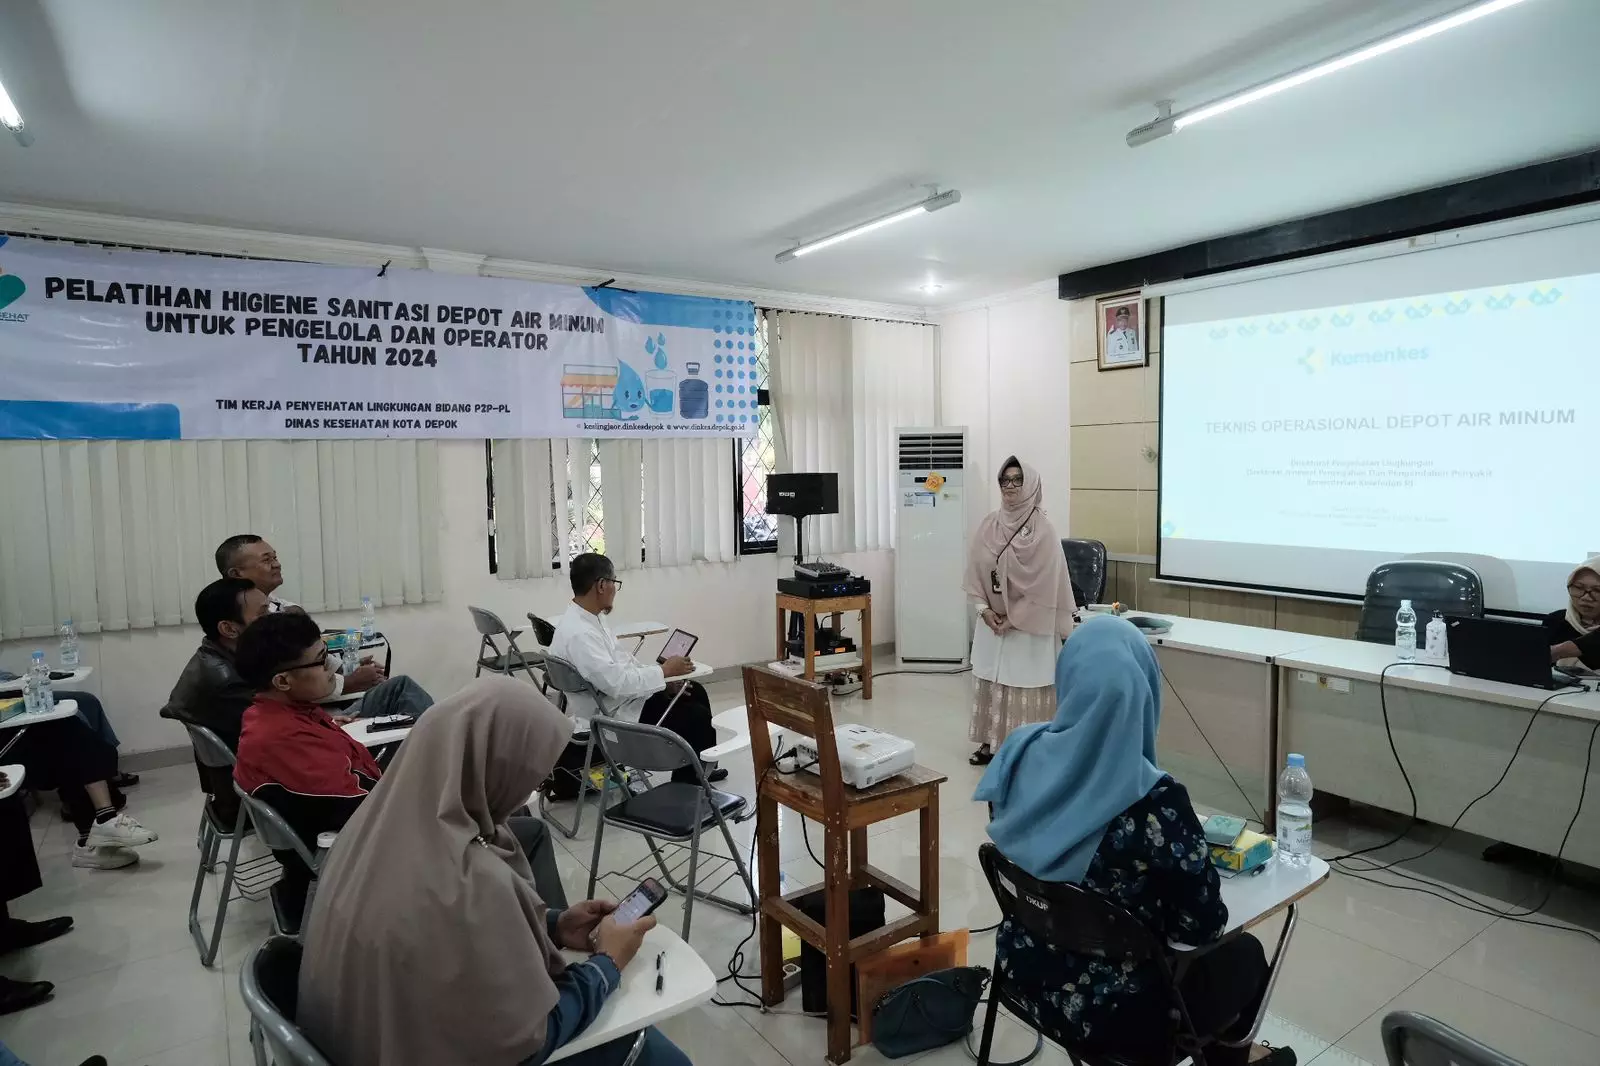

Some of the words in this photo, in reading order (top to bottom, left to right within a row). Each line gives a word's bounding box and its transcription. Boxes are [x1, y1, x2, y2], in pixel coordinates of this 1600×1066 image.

[0, 311, 30, 320] EHAT
[45, 277, 211, 309] PELATIHAN
[222, 290, 318, 315] HIGIENE
[327, 297, 429, 322] SANITASI
[437, 305, 503, 327] DEPOT
[510, 311, 543, 329] AIR
[549, 313, 605, 333] MINUM
[146, 311, 235, 335] UNTUK
[245, 317, 382, 343] PENGELOLA
[391, 325, 436, 345] DAN
[444, 328, 549, 351] OPERATOR
[297, 343, 377, 366] TAHUN
[385, 347, 438, 368] 2024
[1330, 346, 1430, 366] Kemenkes
[216, 399, 238, 410] TIM
[241, 400, 282, 411] KERJA
[286, 401, 364, 412] PENYEHATAN
[367, 402, 432, 412] LINGKUNGAN
[435, 403, 471, 413] BIDANG
[474, 404, 511, 414] P2P-PL
[285, 418, 320, 428] DINAS
[323, 419, 390, 429] KESEHATAN
[393, 419, 422, 429] KOTA
[425, 419, 458, 429] DEPOK
[1205, 420, 1257, 433] TEKNIS
[1262, 416, 1381, 432] OPERASIONAL
[1386, 413, 1453, 429] DEPOT
[1457, 412, 1492, 427] AIR
[1499, 408, 1576, 426] MINUM
